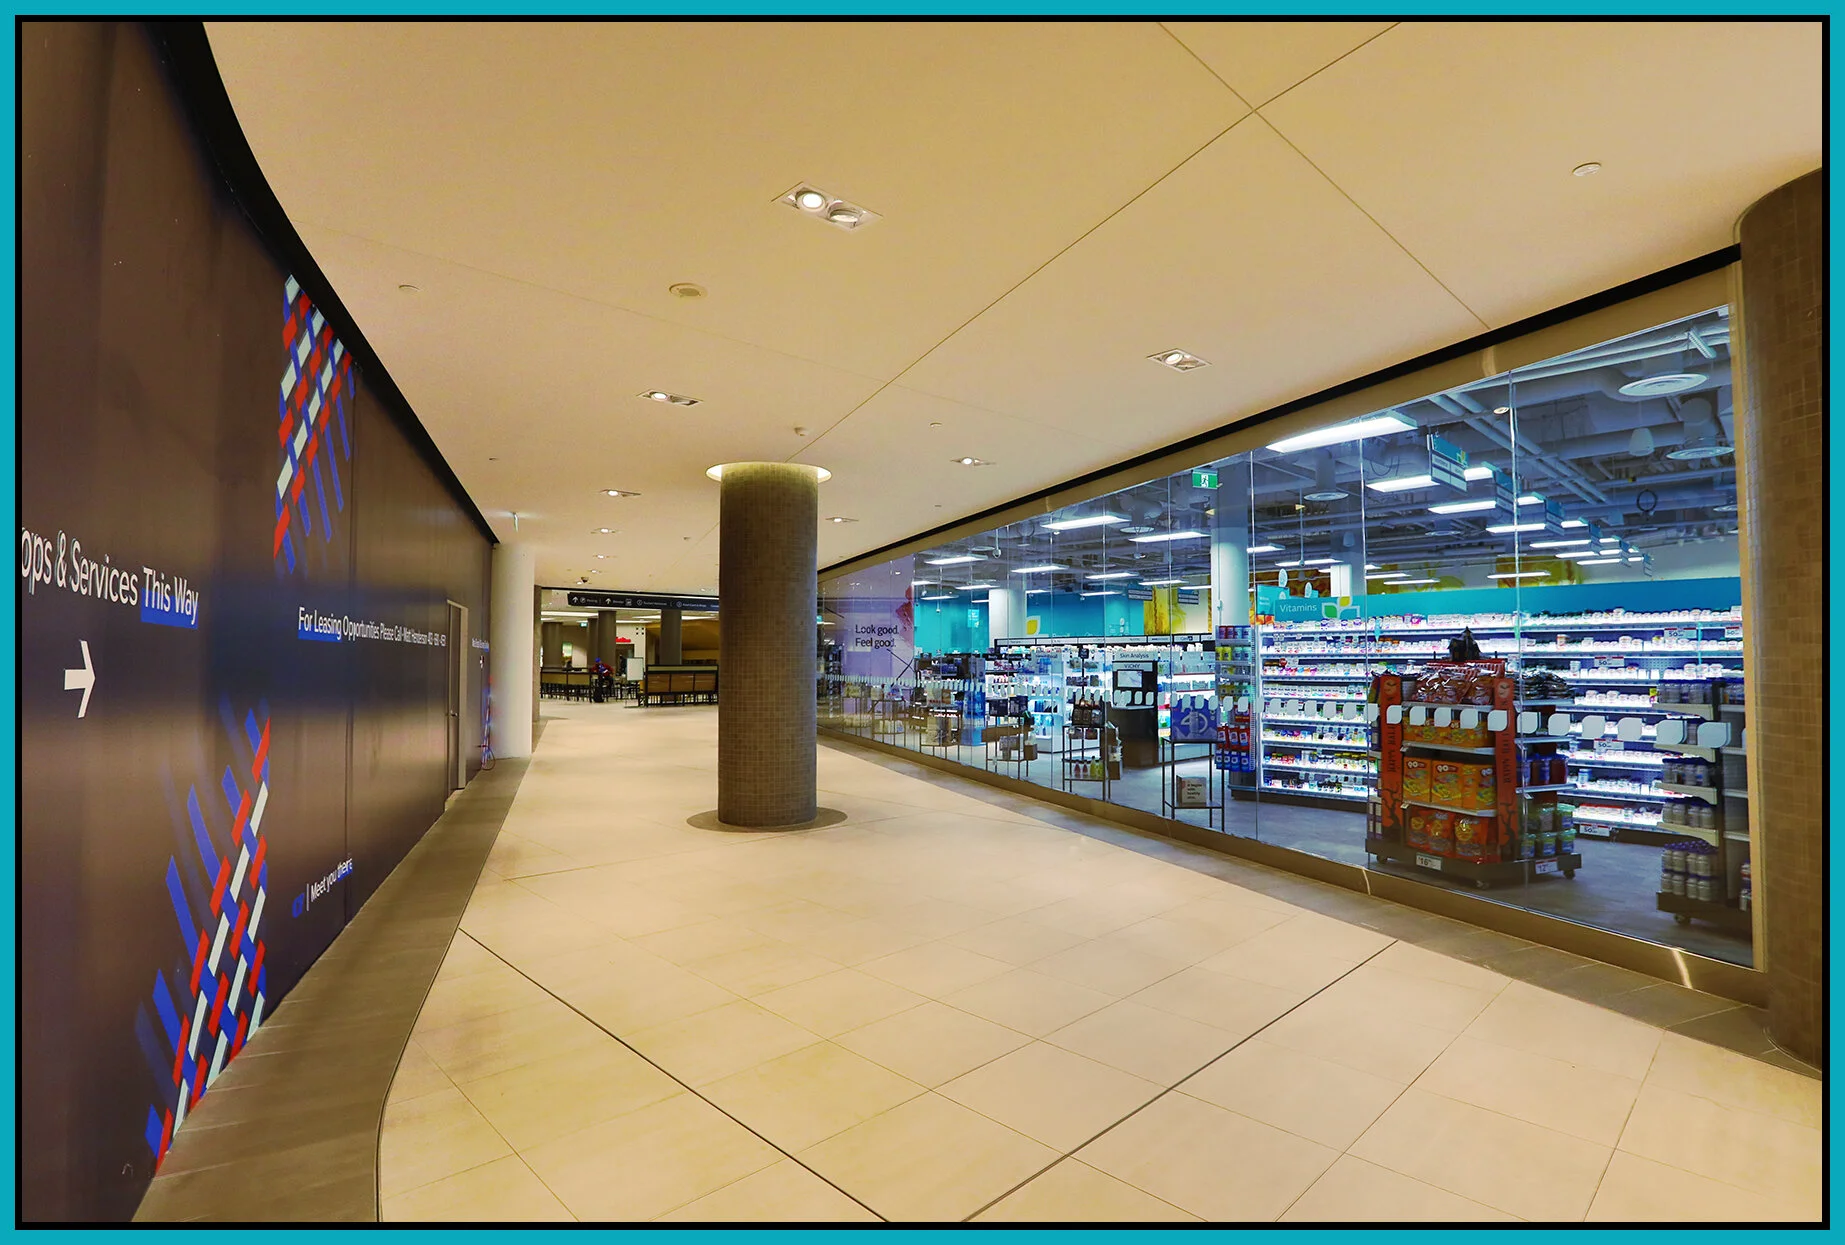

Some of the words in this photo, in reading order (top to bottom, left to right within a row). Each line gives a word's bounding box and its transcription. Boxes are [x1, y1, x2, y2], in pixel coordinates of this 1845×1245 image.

[55, 530, 67, 588] &
[69, 537, 139, 606] Services
[143, 566, 171, 612] This
[174, 576, 199, 625] Way
[1280, 604, 1317, 612] Vitamins
[298, 606, 313, 631] For
[314, 609, 341, 640] Leasing
[855, 624, 876, 634] Look
[855, 637, 873, 647] Feel
[310, 877, 326, 903] Meet
